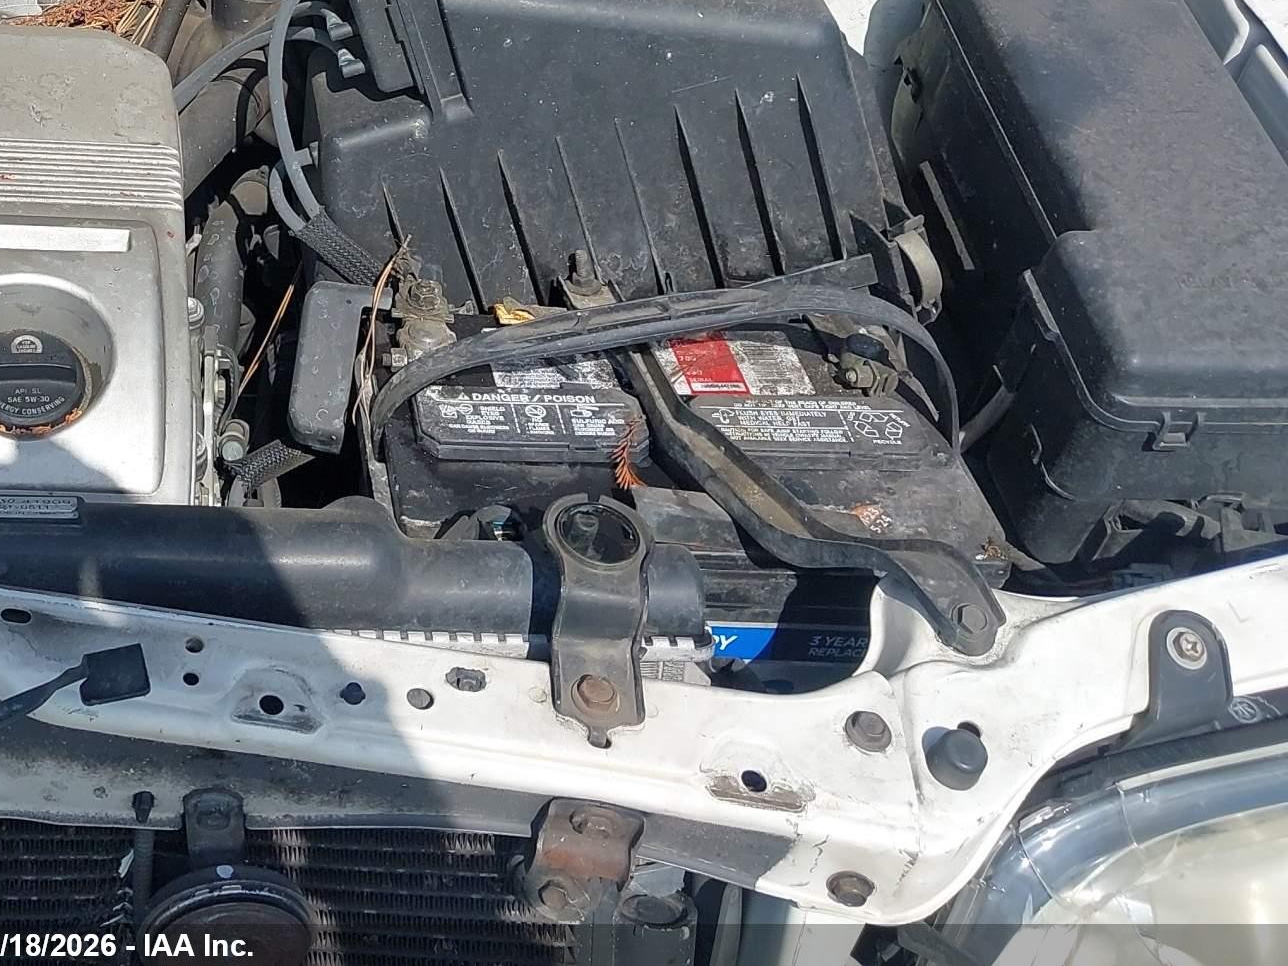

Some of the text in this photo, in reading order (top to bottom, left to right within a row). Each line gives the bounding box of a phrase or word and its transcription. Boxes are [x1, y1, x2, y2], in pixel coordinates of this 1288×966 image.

[25, 396, 50, 404] 5W-30
[471, 392, 530, 402] DANGER
[544, 393, 596, 403] POISON
[22, 396, 66, 415] CONSERVING
[809, 635, 867, 648] 3 YEAR
